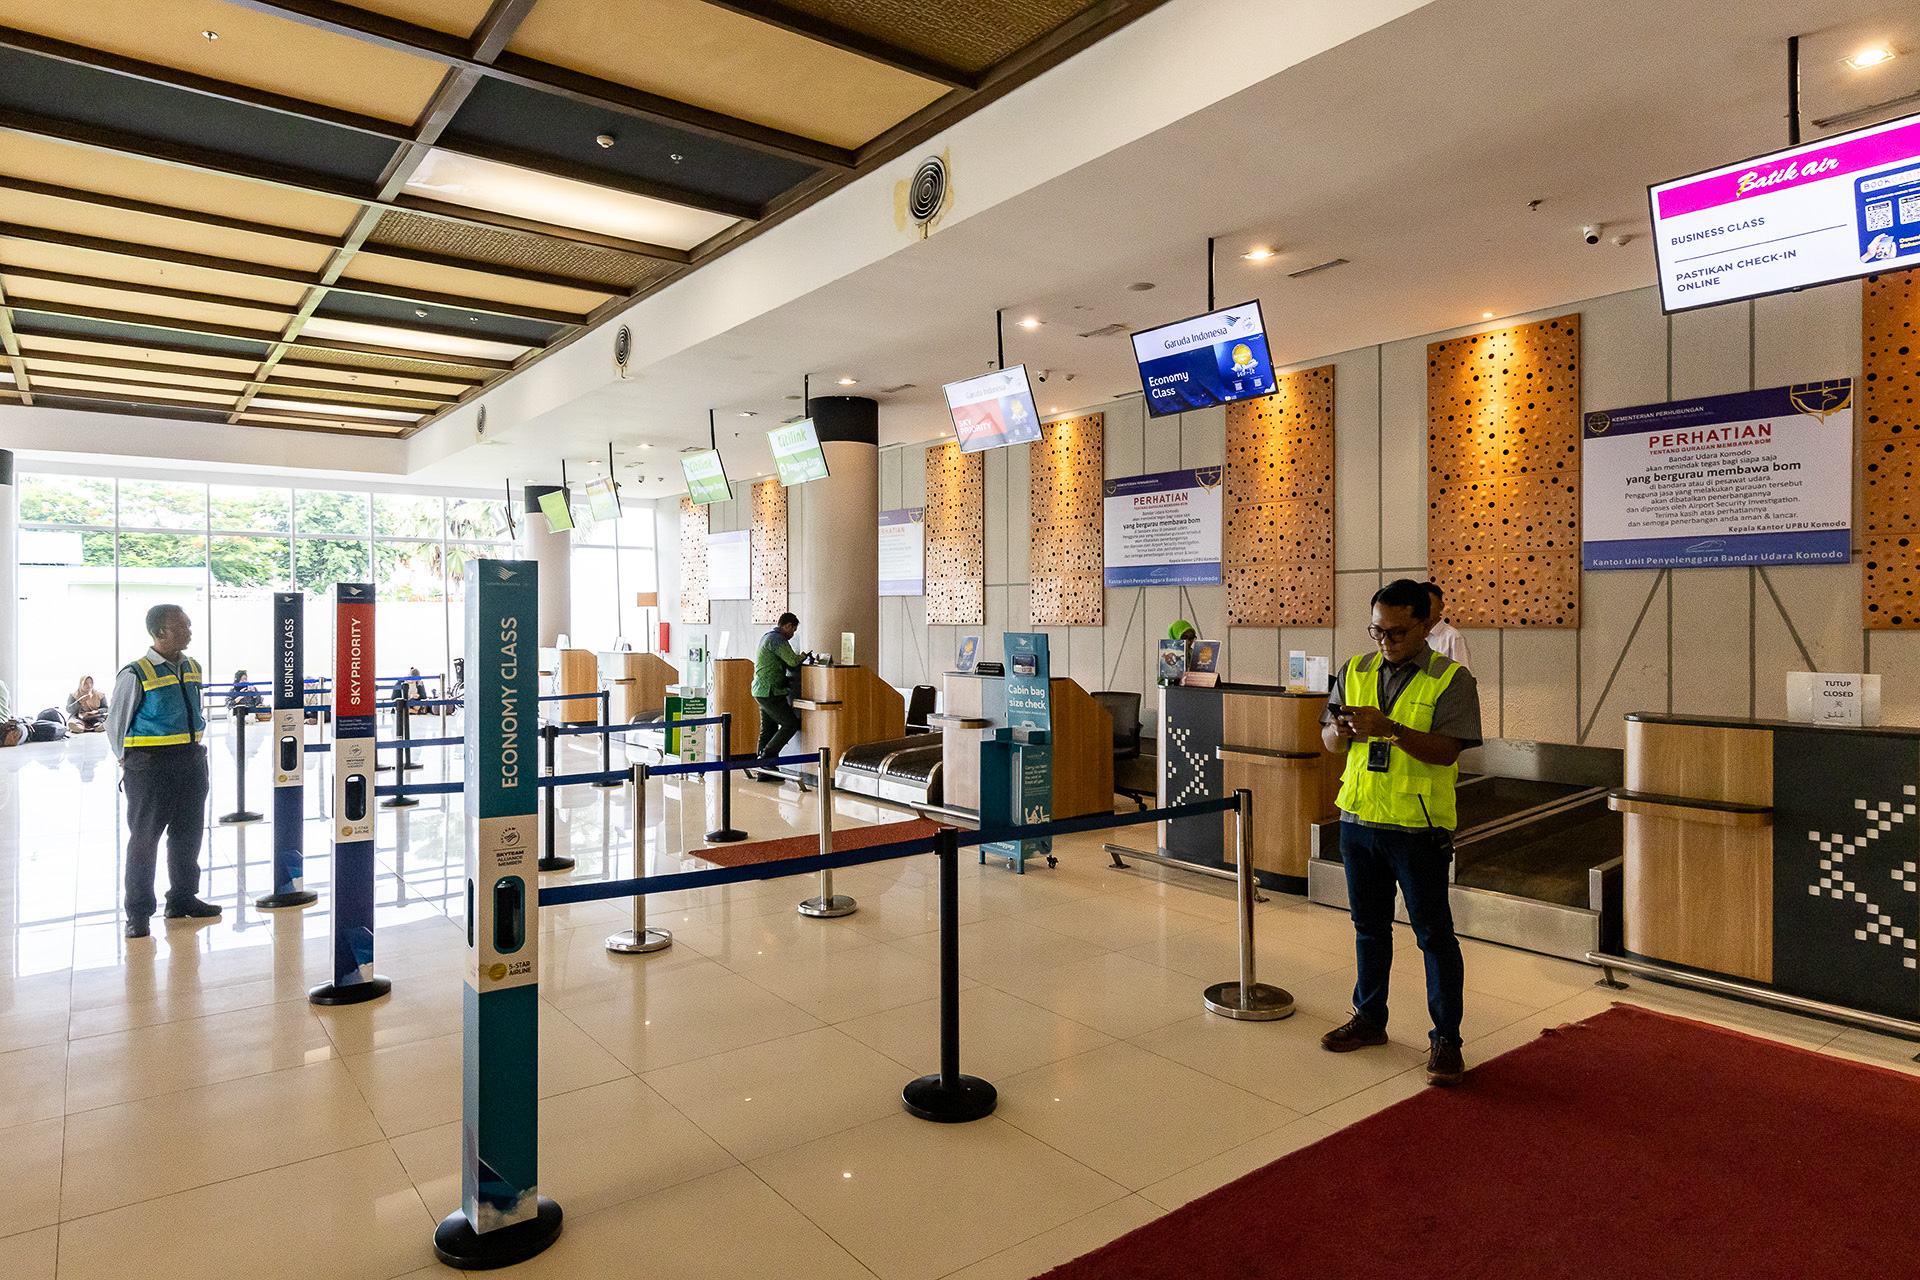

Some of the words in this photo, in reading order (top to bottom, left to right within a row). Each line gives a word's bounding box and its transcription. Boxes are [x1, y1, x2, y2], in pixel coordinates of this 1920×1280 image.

[1736, 161, 1799, 198] Batik
[1670, 226, 1725, 246] BUSINESS
[1727, 216, 1766, 234] CLASS
[1675, 262, 1734, 282] PASTIKAN
[1736, 250, 1797, 270] CHECK-IN
[1677, 277, 1721, 292] ONLINE
[1164, 336, 1191, 350] Garuda
[1191, 326, 1228, 343] Indonesia
[1148, 371, 1189, 387] Economy
[1152, 386, 1176, 399] Class
[1612, 412, 1655, 422] KEMENTERIAN
[1656, 406, 1704, 417] PERHUBUNGAN
[958, 418, 972, 428] SKY
[960, 422, 992, 434] PRIORITY
[1649, 423, 1772, 448] PERHATIAN
[1681, 444, 1716, 453] GURAUAN
[1716, 440, 1754, 448] MEMBAWA
[1664, 462, 1699, 471] menindak
[1700, 460, 1720, 468] tegas
[1722, 458, 1738, 466] bagi
[1740, 456, 1760, 464] siapa
[1762, 454, 1778, 462] saja
[1668, 455, 1694, 463] Bandar
[1696, 452, 1718, 461] Udara
[1720, 449, 1752, 458] Komodo
[1626, 476, 1651, 486] yang
[1654, 470, 1704, 482] bergurau
[1707, 466, 1769, 477] membawa
[1772, 462, 1802, 472] bom
[1624, 492, 1658, 500] Pengguna
[1659, 490, 1674, 498] jasa
[1675, 488, 1692, 497] yang
[1694, 485, 1734, 494] melakukan
[1735, 482, 1767, 492] gurauan
[1768, 480, 1804, 488] tersebut
[1658, 481, 1687, 490] bandara
[1688, 480, 1704, 488] atau
[1714, 476, 1746, 486] pesawat
[1133, 492, 1188, 506] PERHATIAN
[1668, 494, 1706, 504] dibatalkan
[1708, 490, 1772, 502] penerbangannya
[1640, 505, 1670, 513] diproses
[1688, 502, 1714, 510] Airport
[1716, 499, 1746, 508] Security
[1716, 506, 1768, 516] perhatiannya
[1642, 520, 1669, 528] semoga
[1670, 517, 1719, 526] penerbangan
[1764, 512, 1770, 520] &
[1728, 526, 1756, 534] Kepala
[1786, 522, 1809, 530] UPBU
[1810, 520, 1846, 528] Komodo
[1592, 558, 1622, 566] Kantor
[1646, 555, 1719, 566] Penyelenggara
[1721, 553, 1758, 562] Bandar
[1760, 552, 1793, 560] Udara
[1796, 550, 1844, 560] Komodo
[284, 618, 294, 650] CLASS
[501, 616, 518, 680] CLASS
[284, 650, 294, 698] BUSINESS
[1008, 684, 1029, 695] Cabin
[1030, 686, 1046, 699] bag
[1009, 698, 1024, 708] size
[1024, 699, 1046, 710] check
[502, 686, 518, 788] ECONOMY
[509, 960, 530, 970] 5-STAR
[509, 966, 532, 976] AIRLINE
